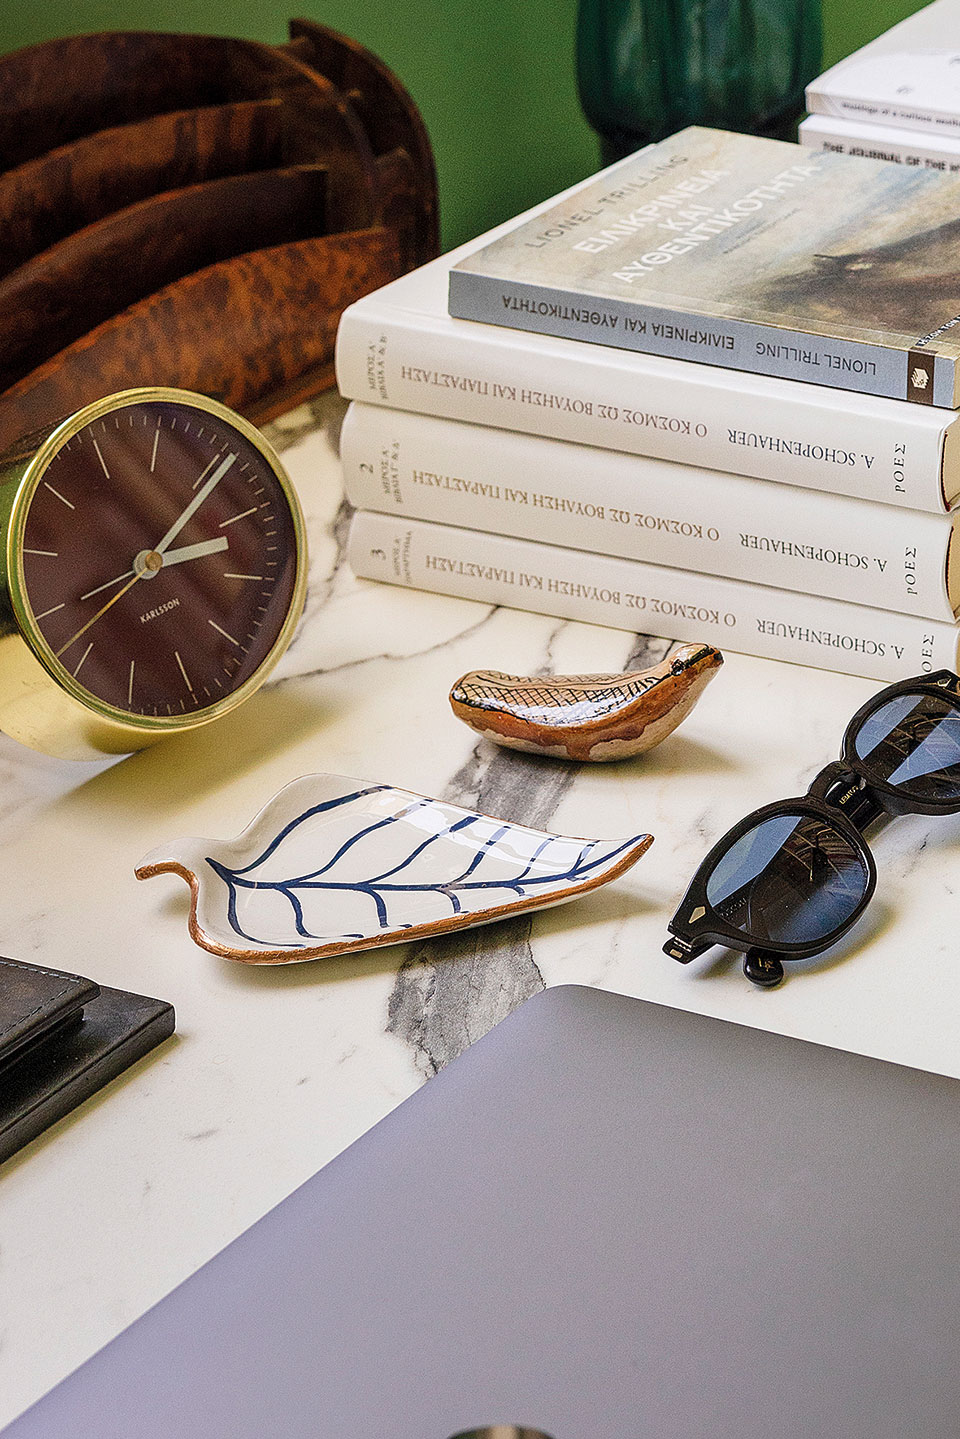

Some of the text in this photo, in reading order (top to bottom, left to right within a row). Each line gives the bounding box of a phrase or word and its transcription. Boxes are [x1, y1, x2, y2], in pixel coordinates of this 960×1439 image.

[905, 155, 920, 165] OF
[925, 159, 946, 170] THE
[525, 153, 689, 249] LIONEL TRILLING
[572, 167, 731, 255] ΕΙΛΙΚΡΙΝΕΙΑ
[612, 164, 823, 283] ΑΥΘΕΝΤΙΚΟΤΗΤΑ
[658, 203, 713, 232] ΚΑΙ
[501, 294, 735, 350] ΕΙΛΙΚΡΙΝΕΙΑ ΚΑΙ ΑΥΘΕΝΤΙΚΟΤΗΤΑ
[755, 342, 877, 375] LIONEL TRILLING
[401, 365, 488, 395] ΠΑΡΑΣΤΑΣΗ
[493, 383, 517, 400] ΚΑΙ
[521, 389, 593, 416] ΒΟΥΛΗΣΗ
[597, 404, 618, 421] ΩΣ
[623, 408, 691, 435] ΚΟΣΜΟΣ
[727, 428, 875, 469] A. SCHOPENHAUER
[359, 463, 374, 474] 2
[412, 469, 500, 499] ΠΑΡΑΣΤΑΣΗ
[504, 487, 528, 505] ΚΑΙ
[533, 493, 605, 519] ΒΟΥΛΗΣΗ
[609, 508, 631, 524] ΩΣ
[635, 513, 703, 539] ΚΟΣΜΟΣ
[371, 548, 386, 561] 3
[739, 532, 888, 572] A. SCHOPENHAUER
[425, 554, 515, 584] ΠΑΡΑΣΤΑΣΗ
[519, 572, 543, 590] ΚΑΙ
[548, 578, 621, 605] ΒΟΥΛΗΣΗ
[625, 593, 646, 609] ΩΣ
[140, 598, 180, 624] KARLSSON
[651, 598, 719, 624] ΚΟΣΜΟΣ
[756, 618, 905, 660] A. SCHOPENHAUER
[921, 634, 935, 673] ΟΕΣ
